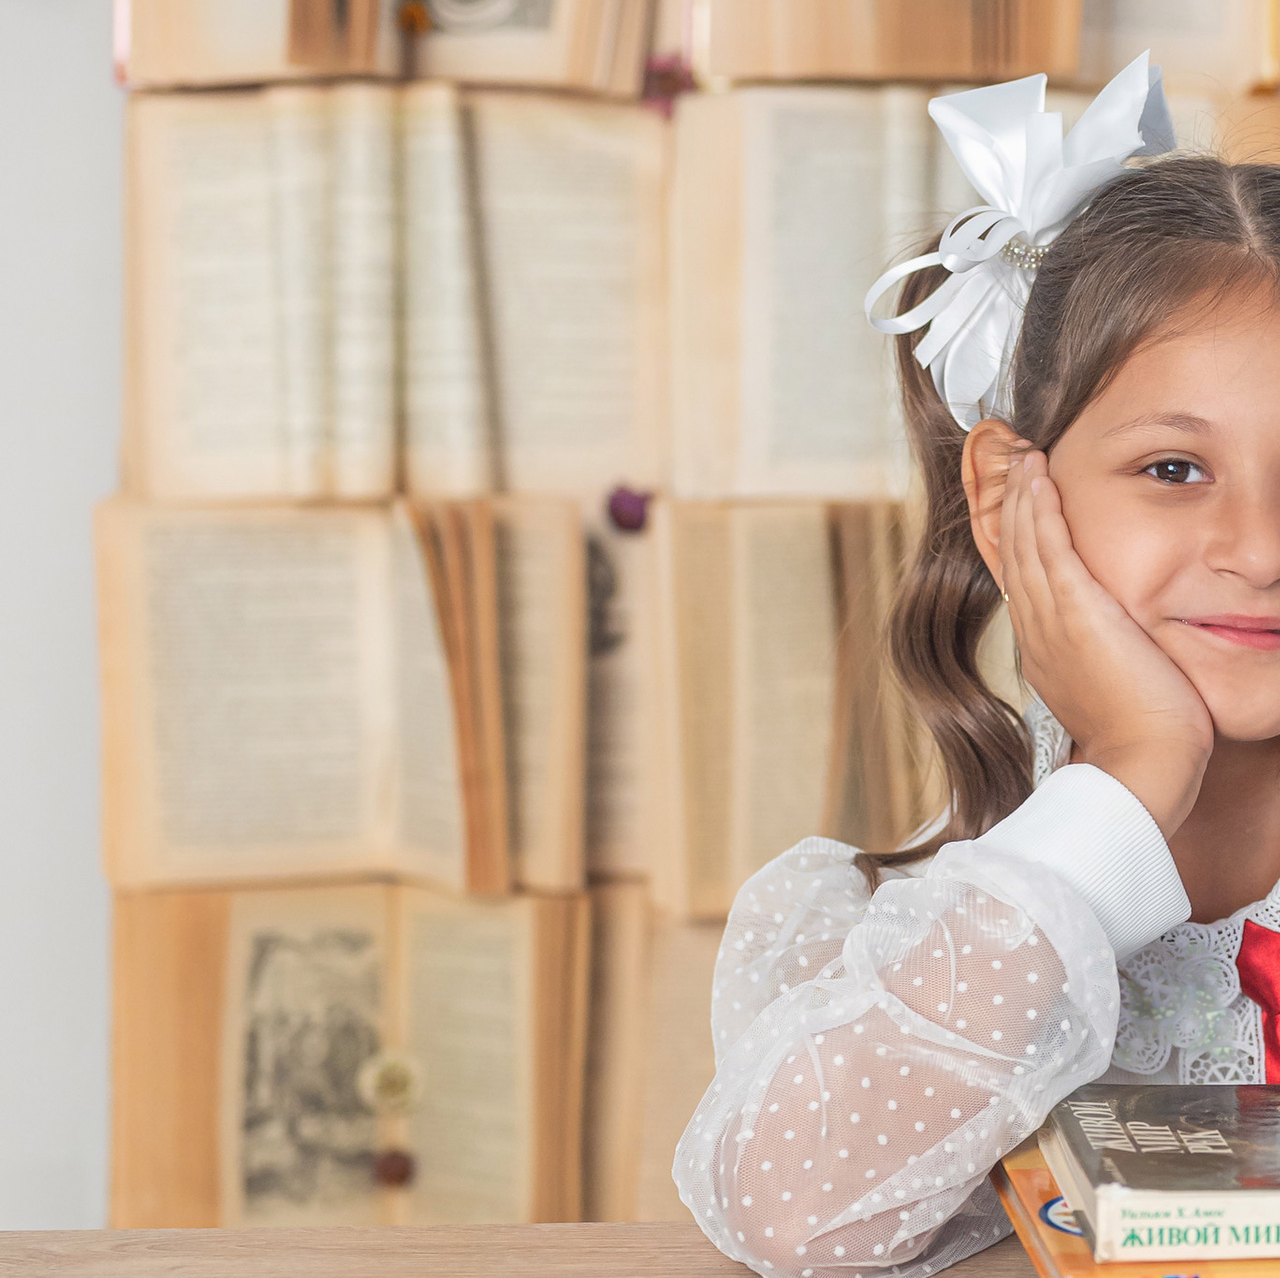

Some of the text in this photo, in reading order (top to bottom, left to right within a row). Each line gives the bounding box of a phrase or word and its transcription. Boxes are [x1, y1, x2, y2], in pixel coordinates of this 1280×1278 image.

[1061, 1101, 1137, 1153] ЖИВОЙ
[1126, 1121, 1185, 1154] МИР
[1177, 1129, 1234, 1154] РЕК
[1121, 1223, 1221, 1248] ЖИВОЙ
